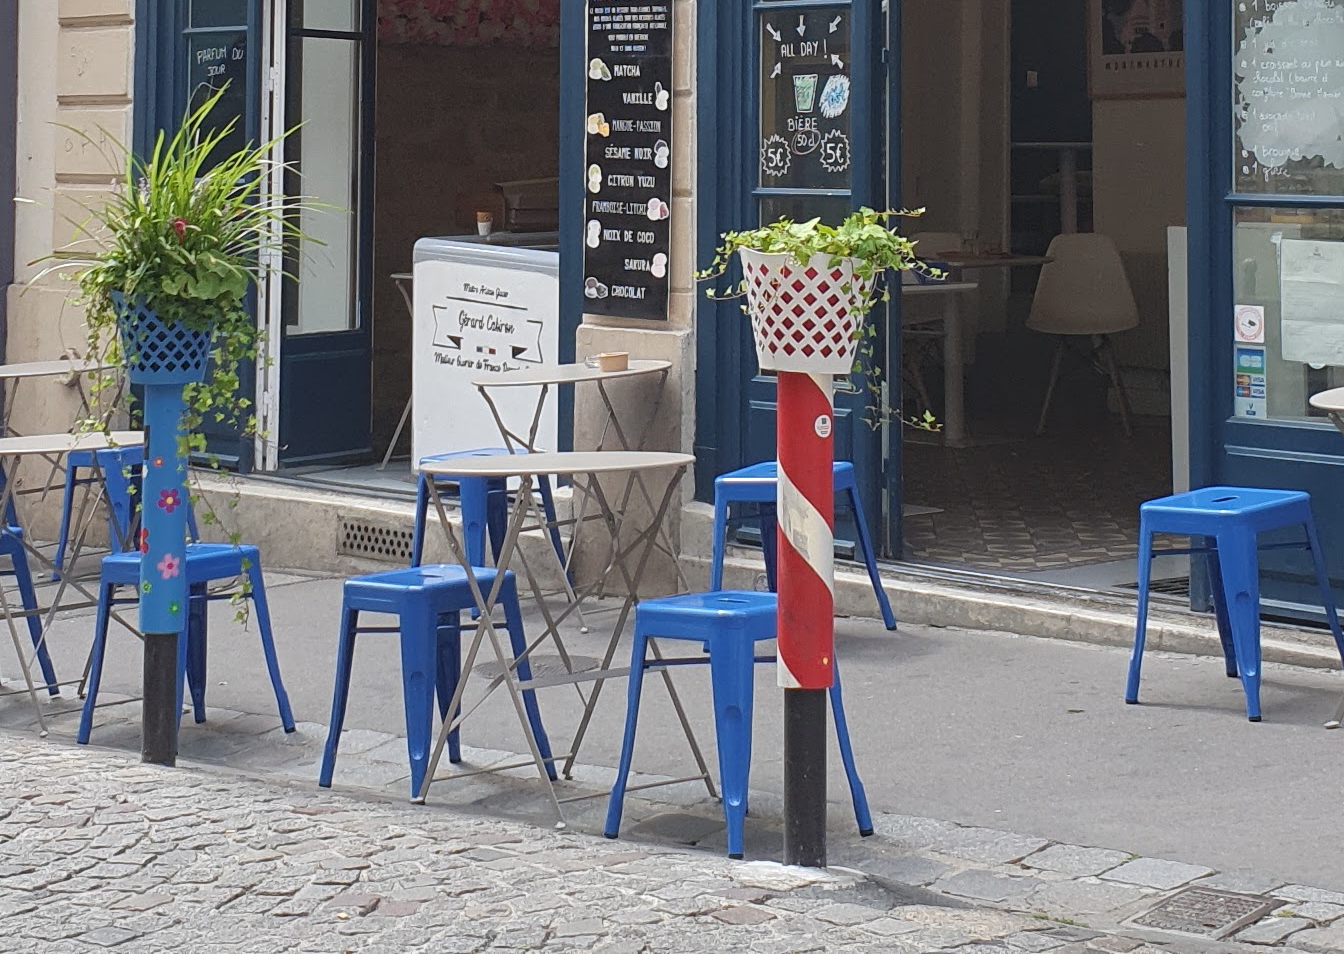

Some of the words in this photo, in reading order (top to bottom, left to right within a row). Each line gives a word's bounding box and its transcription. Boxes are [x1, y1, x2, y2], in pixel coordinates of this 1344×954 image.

[196, 46, 227, 64] PARFUM
[232, 47, 244, 60] DU
[781, 43, 795, 58] ALL
[800, 40, 819, 57] DAY
[207, 64, 226, 77] JOUR
[614, 64, 641, 77] MATCHA
[622, 92, 653, 105] VANILLE
[787, 115, 818, 132] BIÈRE
[797, 134, 807, 147] 50
[634, 146, 653, 160] NOIR
[768, 148, 784, 167] 5€
[826, 143, 844, 164] 5€
[608, 174, 635, 187] CITRON
[637, 175, 656, 189] YUZU
[603, 229, 621, 242] NOIX
[624, 230, 634, 242] DE
[636, 231, 655, 244] COCO
[624, 258, 651, 271] SAKURA
[611, 285, 646, 300] CHOCOLAT
